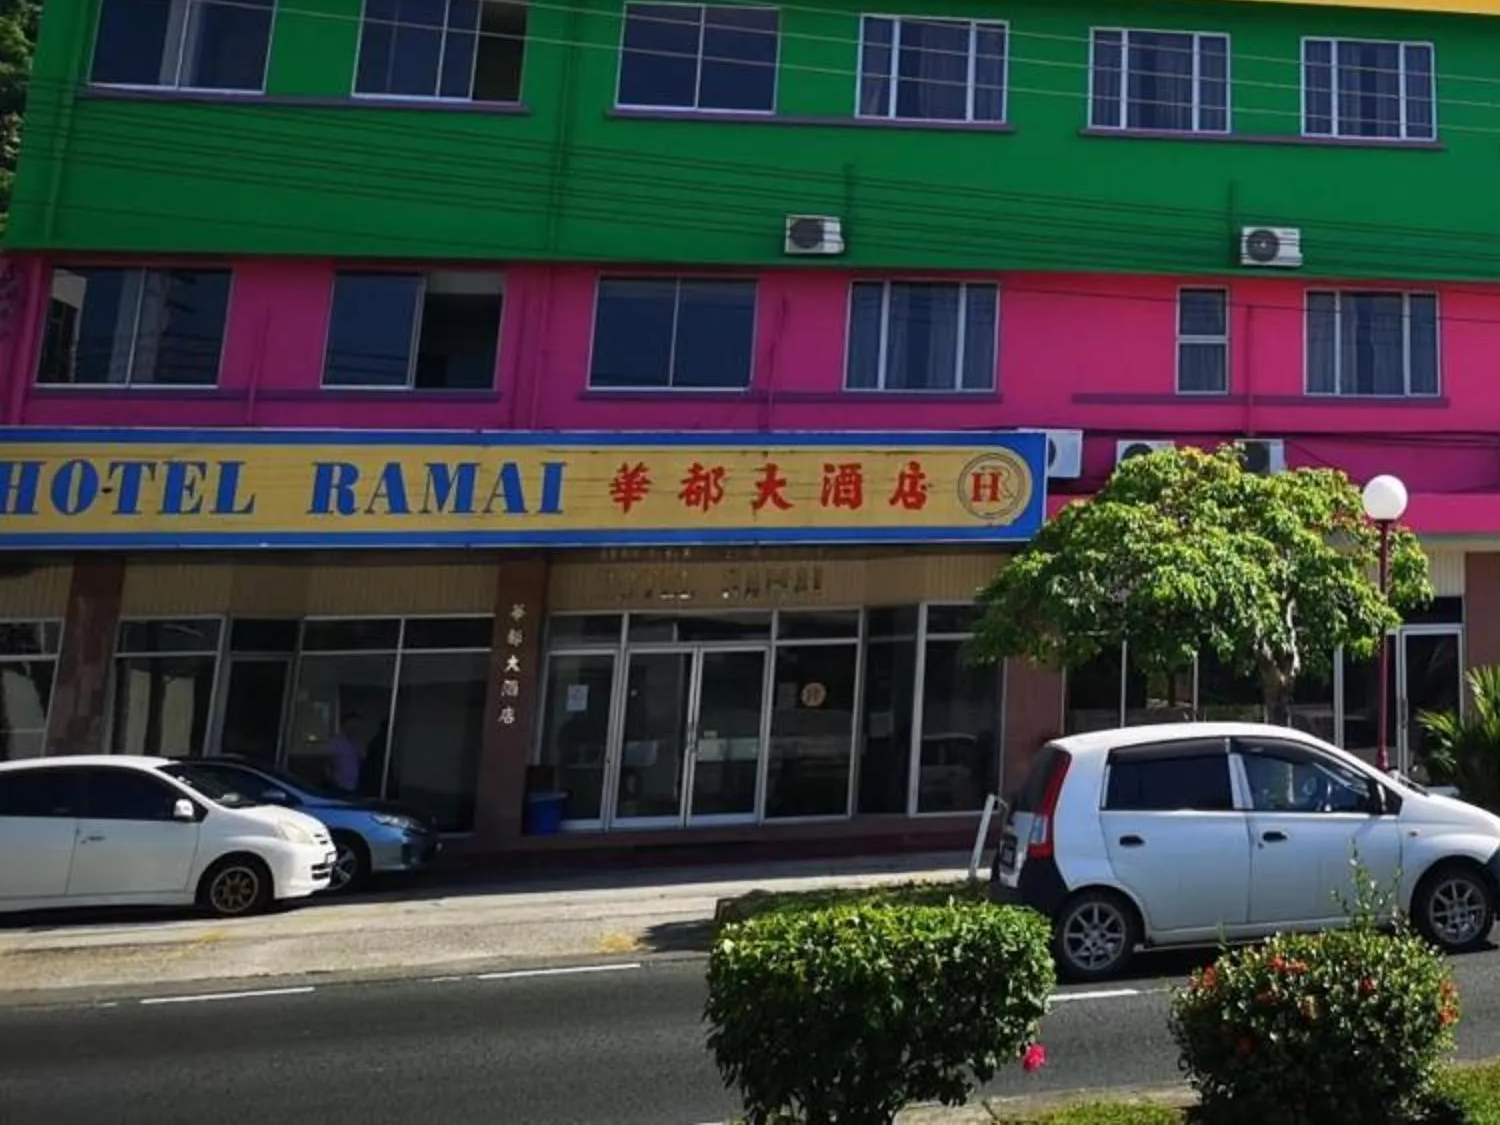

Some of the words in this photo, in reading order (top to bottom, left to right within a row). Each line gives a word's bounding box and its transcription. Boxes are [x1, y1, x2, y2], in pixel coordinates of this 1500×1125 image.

[306, 461, 568, 515] RAMAI
[608, 461, 931, 514] 華都大酒店
